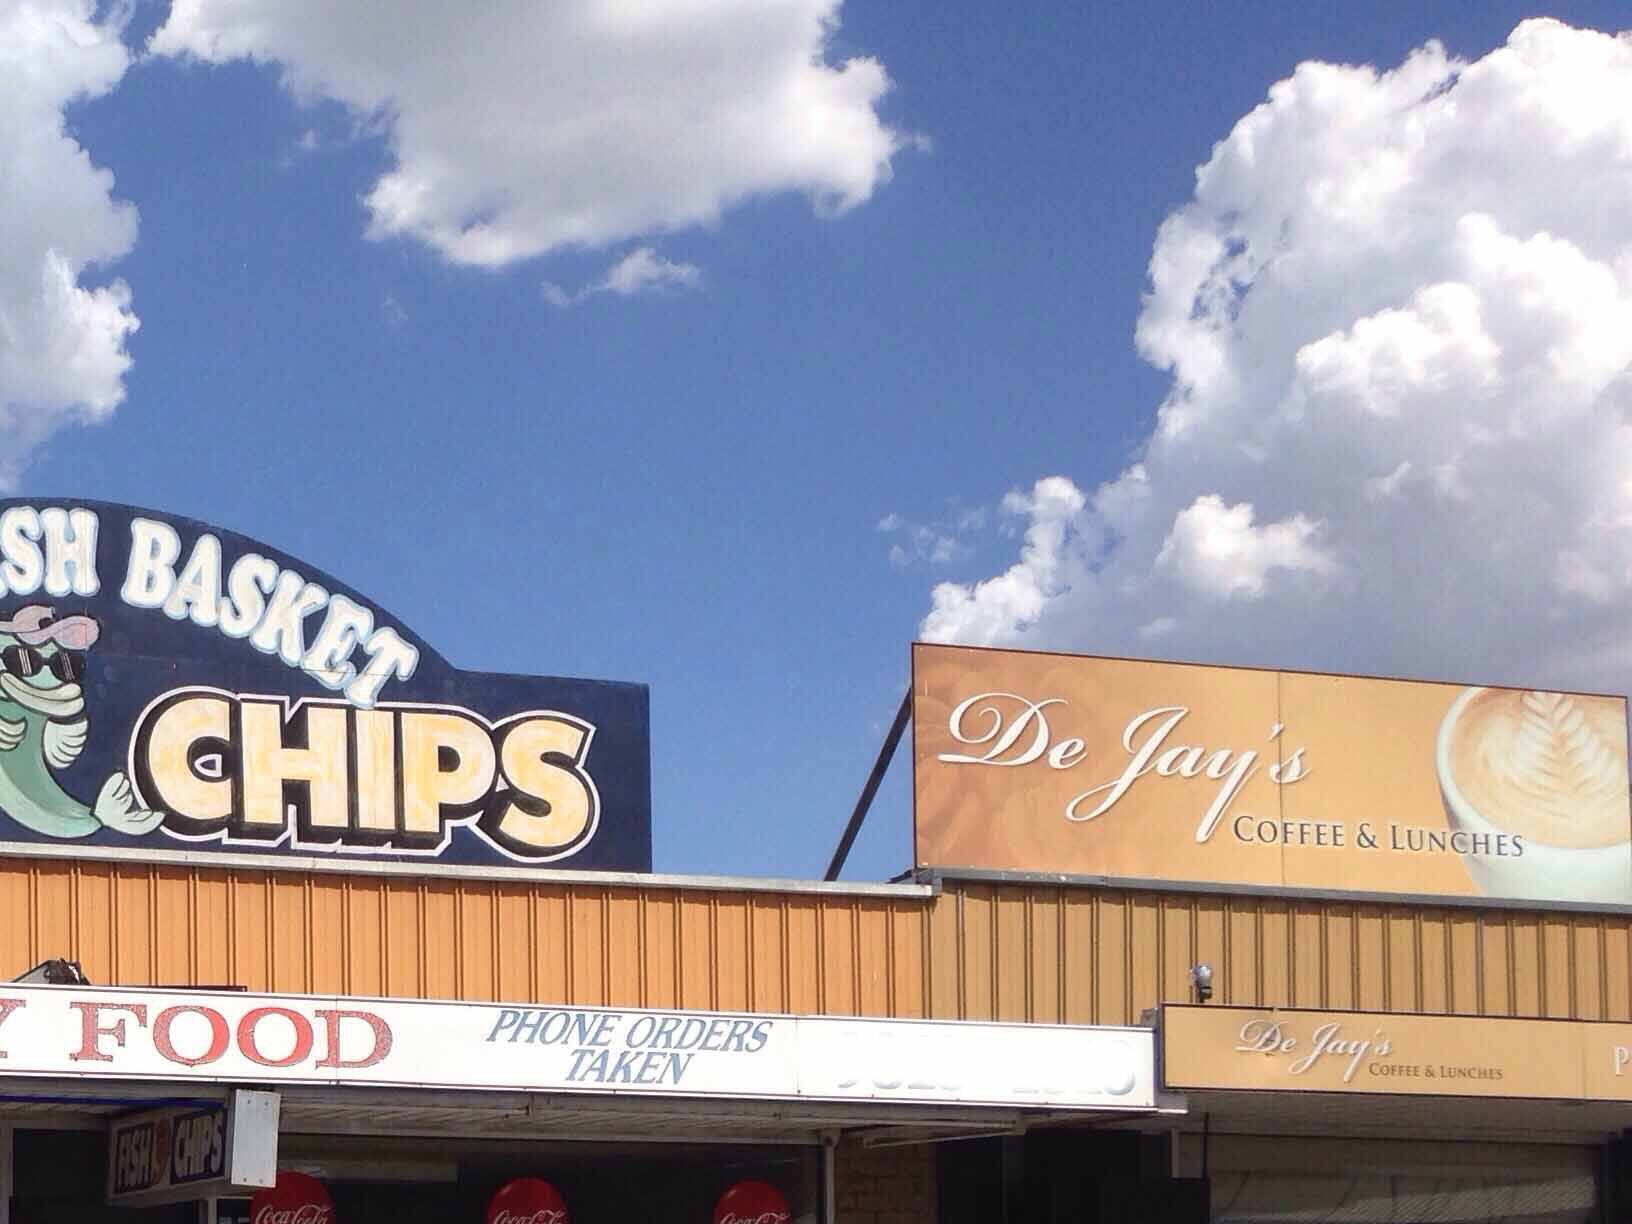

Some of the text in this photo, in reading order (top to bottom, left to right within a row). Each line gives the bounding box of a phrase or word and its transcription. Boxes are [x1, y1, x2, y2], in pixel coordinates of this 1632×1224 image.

[121, 517, 419, 708] BASKET
[134, 690, 596, 858] CHIPS
[937, 692, 1311, 844] De Jay's
[1234, 816, 1526, 858] COFFEE & LUNCHES
[69, 1000, 394, 1069] FOOD
[486, 1010, 773, 1054] PHONE ORDERS
[1235, 1019, 1393, 1082] De Jay's
[565, 1050, 696, 1086] TAKEN
[1369, 1062, 1504, 1081] COFFEE & LUNCHES
[174, 1110, 223, 1179] CHIPS
